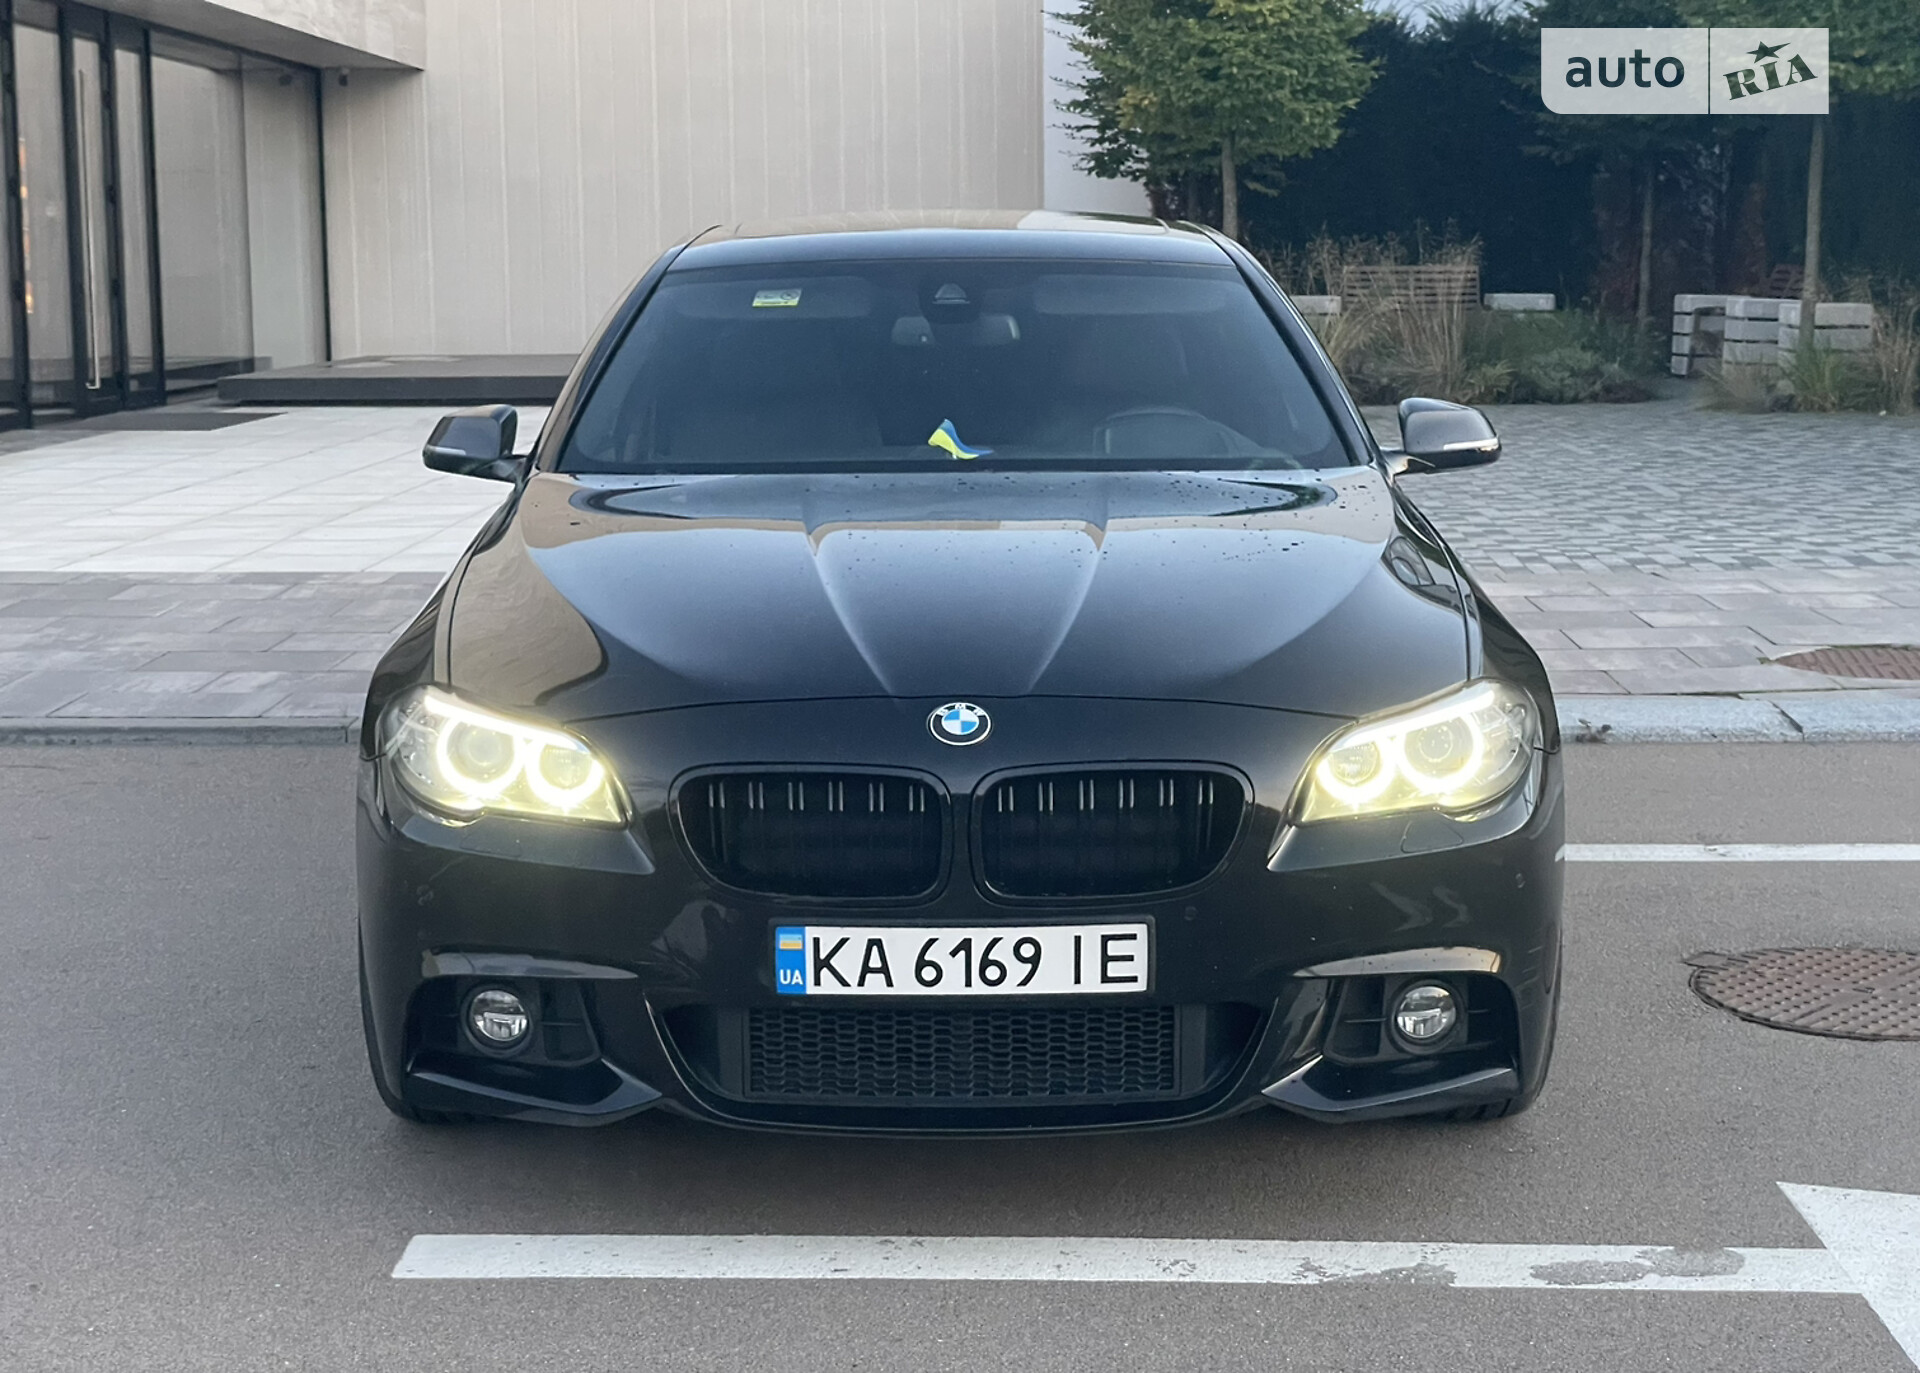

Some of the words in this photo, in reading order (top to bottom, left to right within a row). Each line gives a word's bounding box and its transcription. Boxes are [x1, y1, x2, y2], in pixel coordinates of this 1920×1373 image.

[779, 968, 804, 986] UA
[812, 936, 894, 988] KA
[914, 936, 1043, 988] 6169
[1073, 933, 1139, 985] IE
